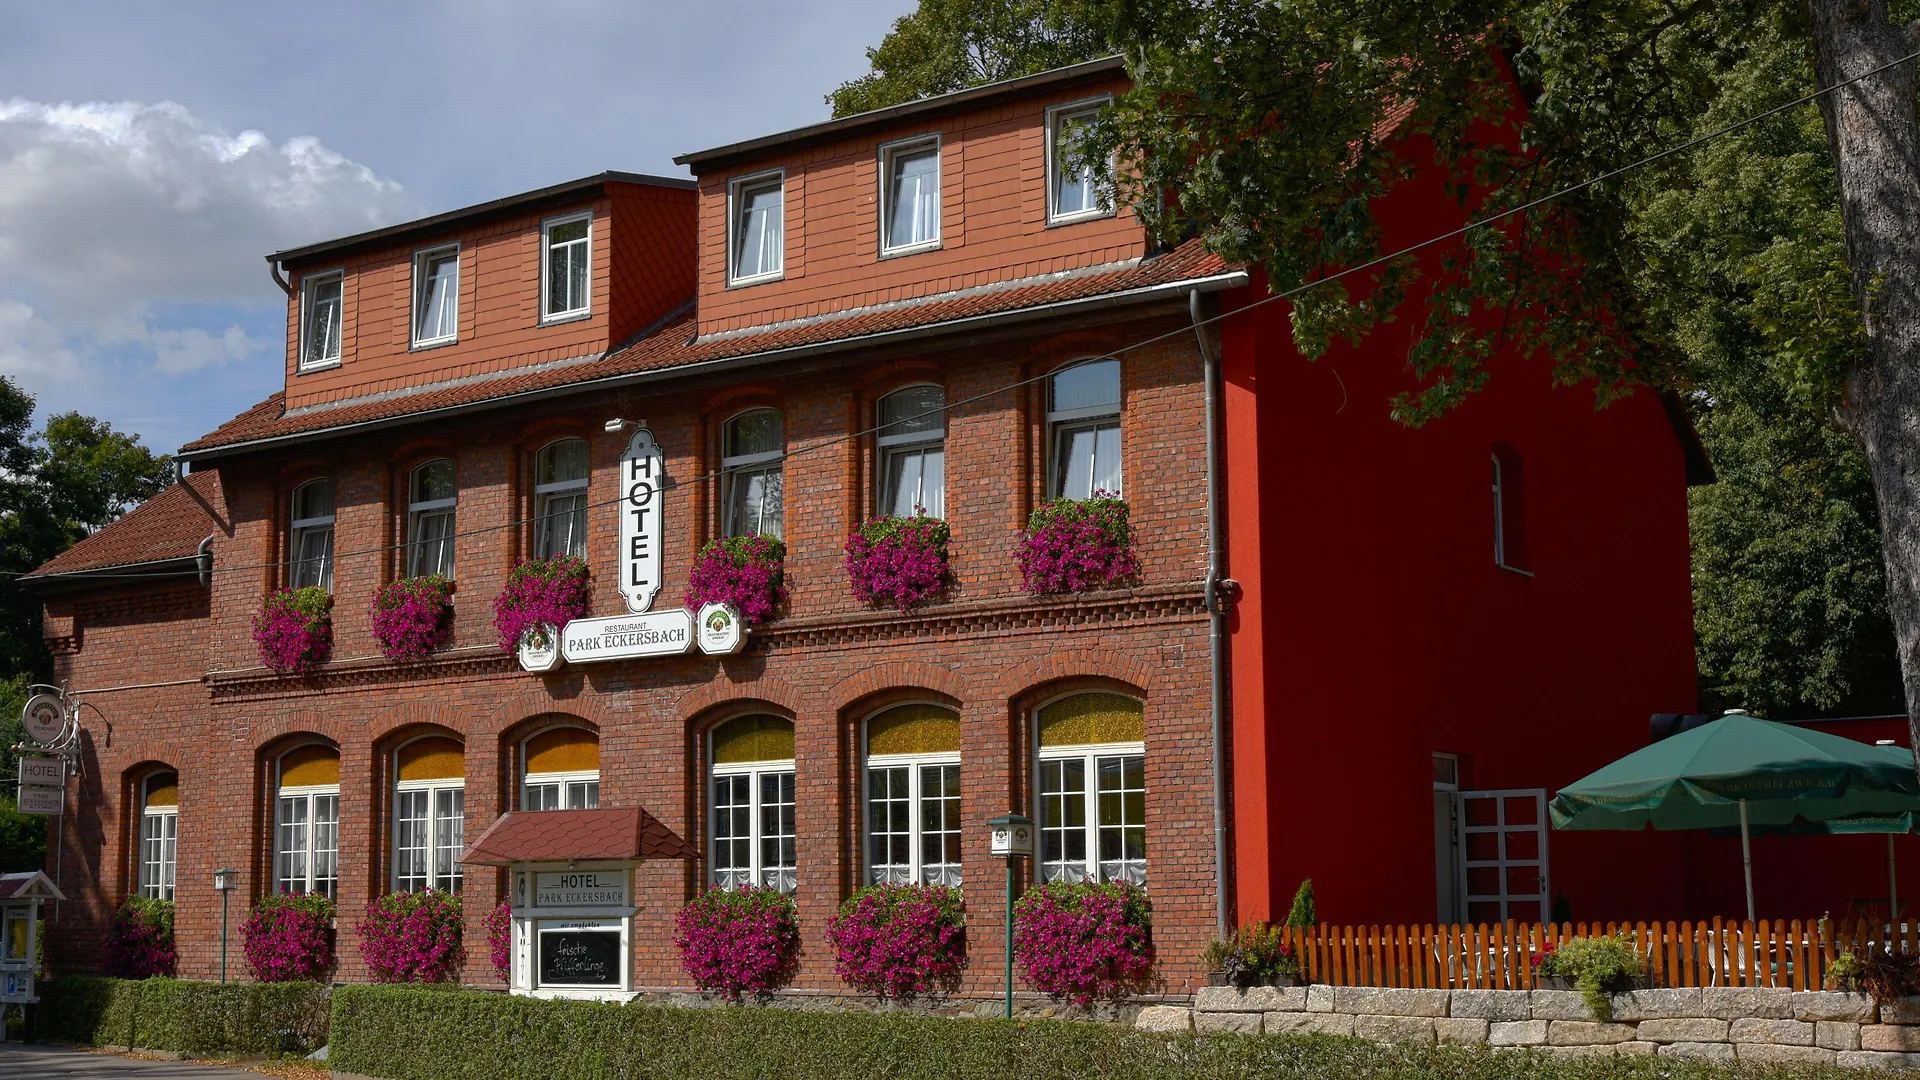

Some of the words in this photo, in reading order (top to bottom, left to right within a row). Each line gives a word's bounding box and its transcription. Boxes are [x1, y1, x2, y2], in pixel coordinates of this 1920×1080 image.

[629, 455, 652, 586] HOTEL
[604, 622, 647, 633] RESTAURANT
[569, 636, 602, 652] PARK
[604, 628, 685, 648] ECKERSBACH
[24, 765, 60, 777] HOTEL
[561, 874, 600, 889] HOTEL
[539, 893, 562, 903] PARK
[566, 891, 623, 902] ECKERSBACH
[558, 937, 588, 957] frische
